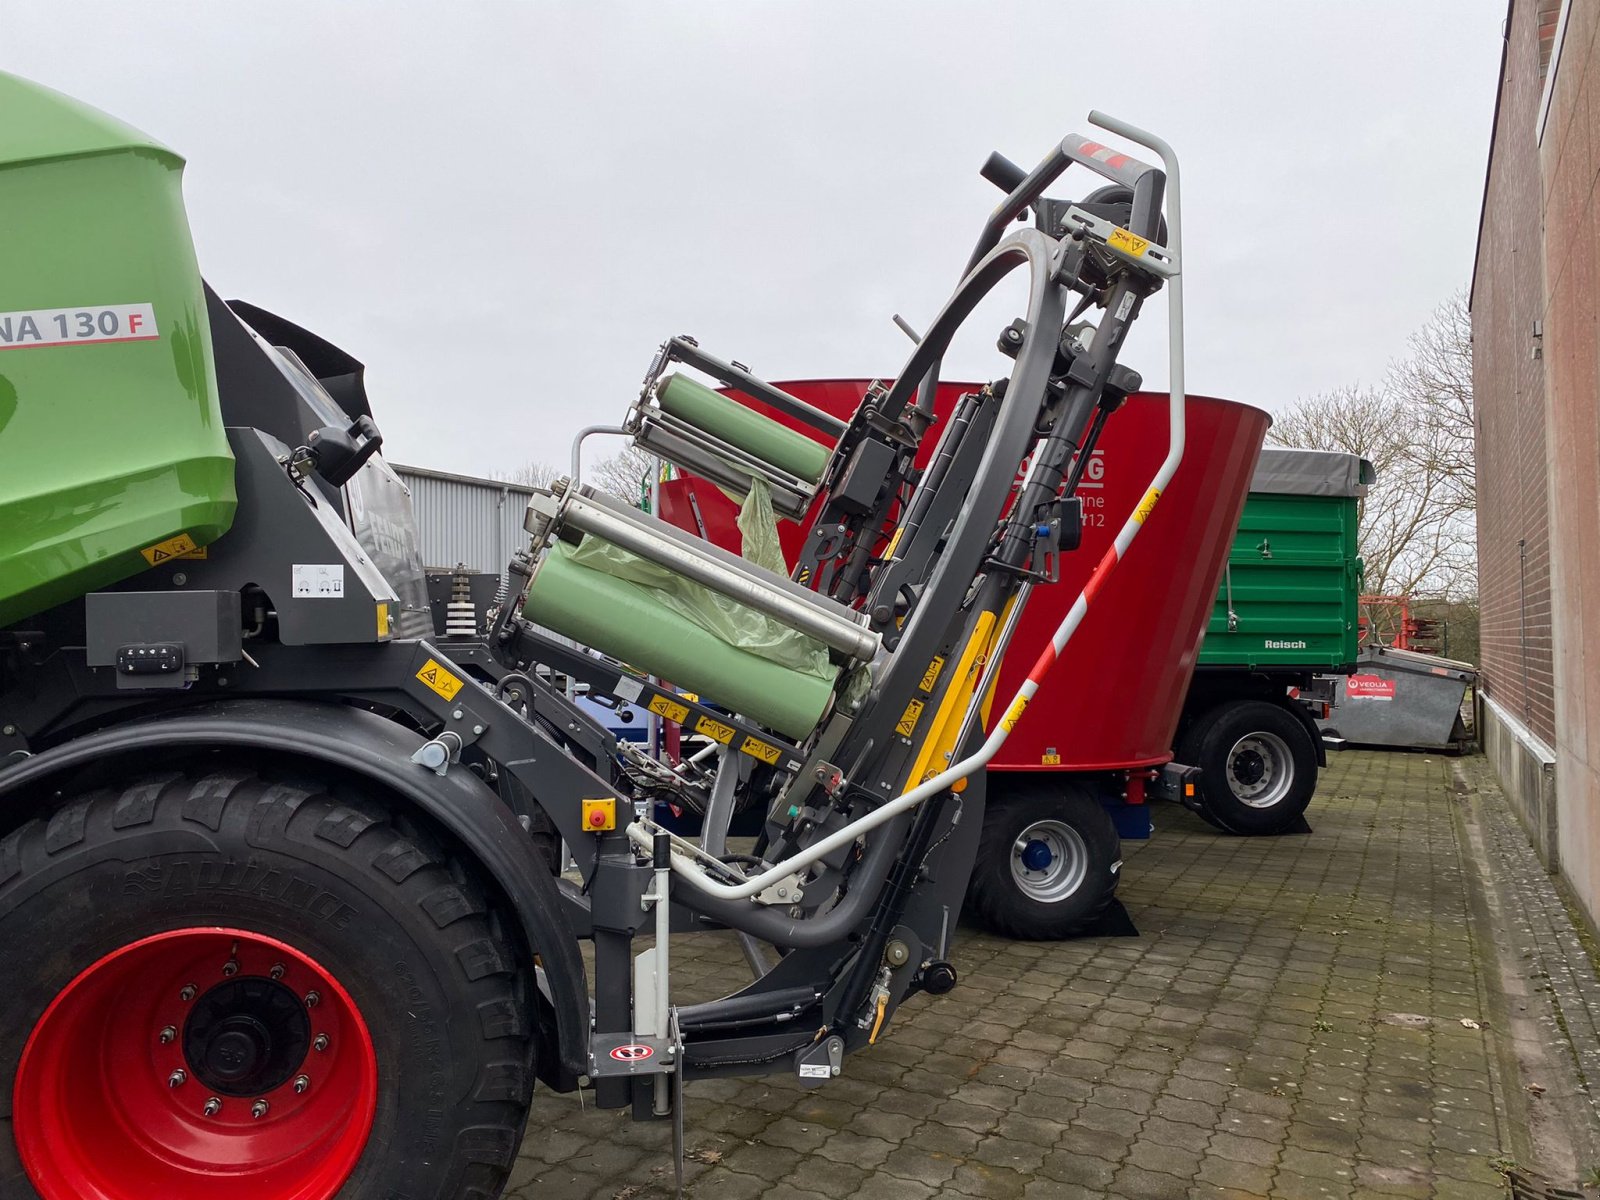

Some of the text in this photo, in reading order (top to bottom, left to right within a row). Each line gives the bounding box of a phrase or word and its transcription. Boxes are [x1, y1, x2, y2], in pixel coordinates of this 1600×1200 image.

[53, 311, 119, 339] 130
[129, 314, 143, 334] F
[1264, 640, 1306, 649] Reisch
[161, 860, 360, 932] ALLIANCE
